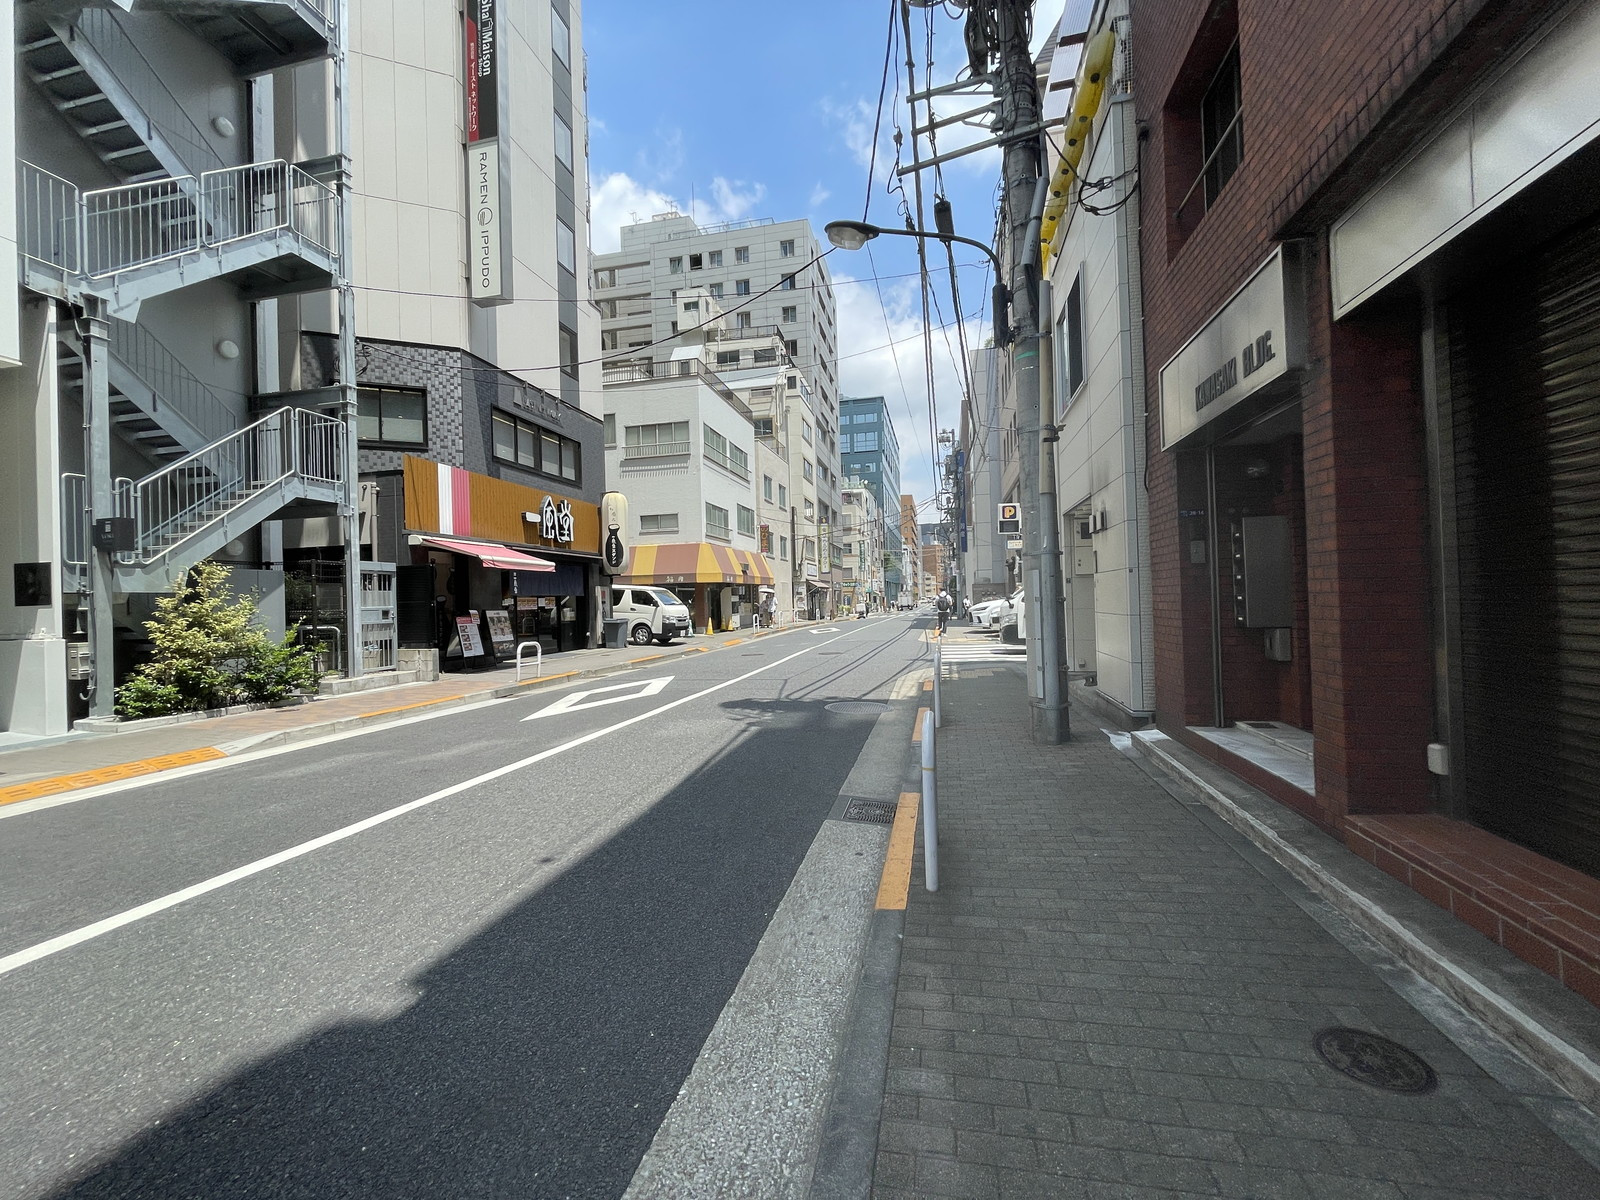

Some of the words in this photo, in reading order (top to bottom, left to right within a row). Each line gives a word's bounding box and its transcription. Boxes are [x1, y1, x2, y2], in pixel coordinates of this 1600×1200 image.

[482, 31, 493, 76] Maison
[480, 152, 488, 204] RAMEN
[481, 229, 490, 288] IPPUDO
[1195, 356, 1238, 413] KAWASAKI
[522, 494, 575, 543] 一風堂
[1003, 506, 1015, 519] P
